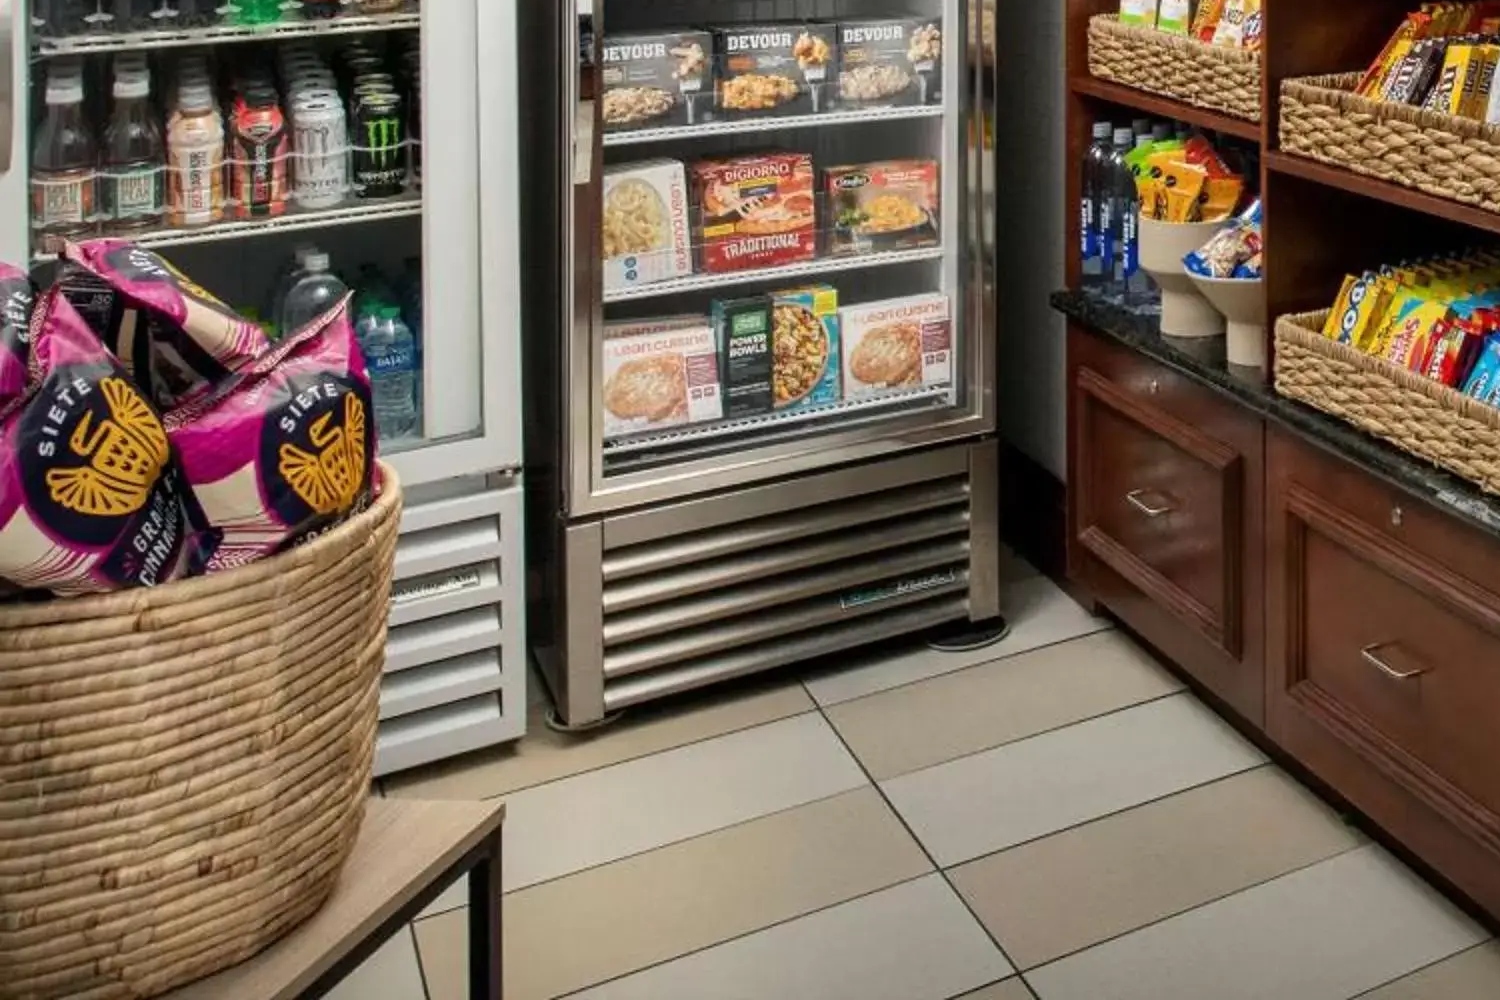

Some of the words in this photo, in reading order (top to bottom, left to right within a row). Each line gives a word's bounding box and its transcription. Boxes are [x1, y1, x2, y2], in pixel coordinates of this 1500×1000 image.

[727, 32, 793, 51] DEVOUR
[843, 25, 904, 44] DEVOUR
[724, 163, 790, 182] DIGIORNO
[724, 232, 801, 261] TRADITIONAL
[729, 334, 767, 348] POWER
[729, 344, 768, 358] BOWLS
[38, 376, 93, 457] SIETE
[280, 382, 340, 434] SIETE
